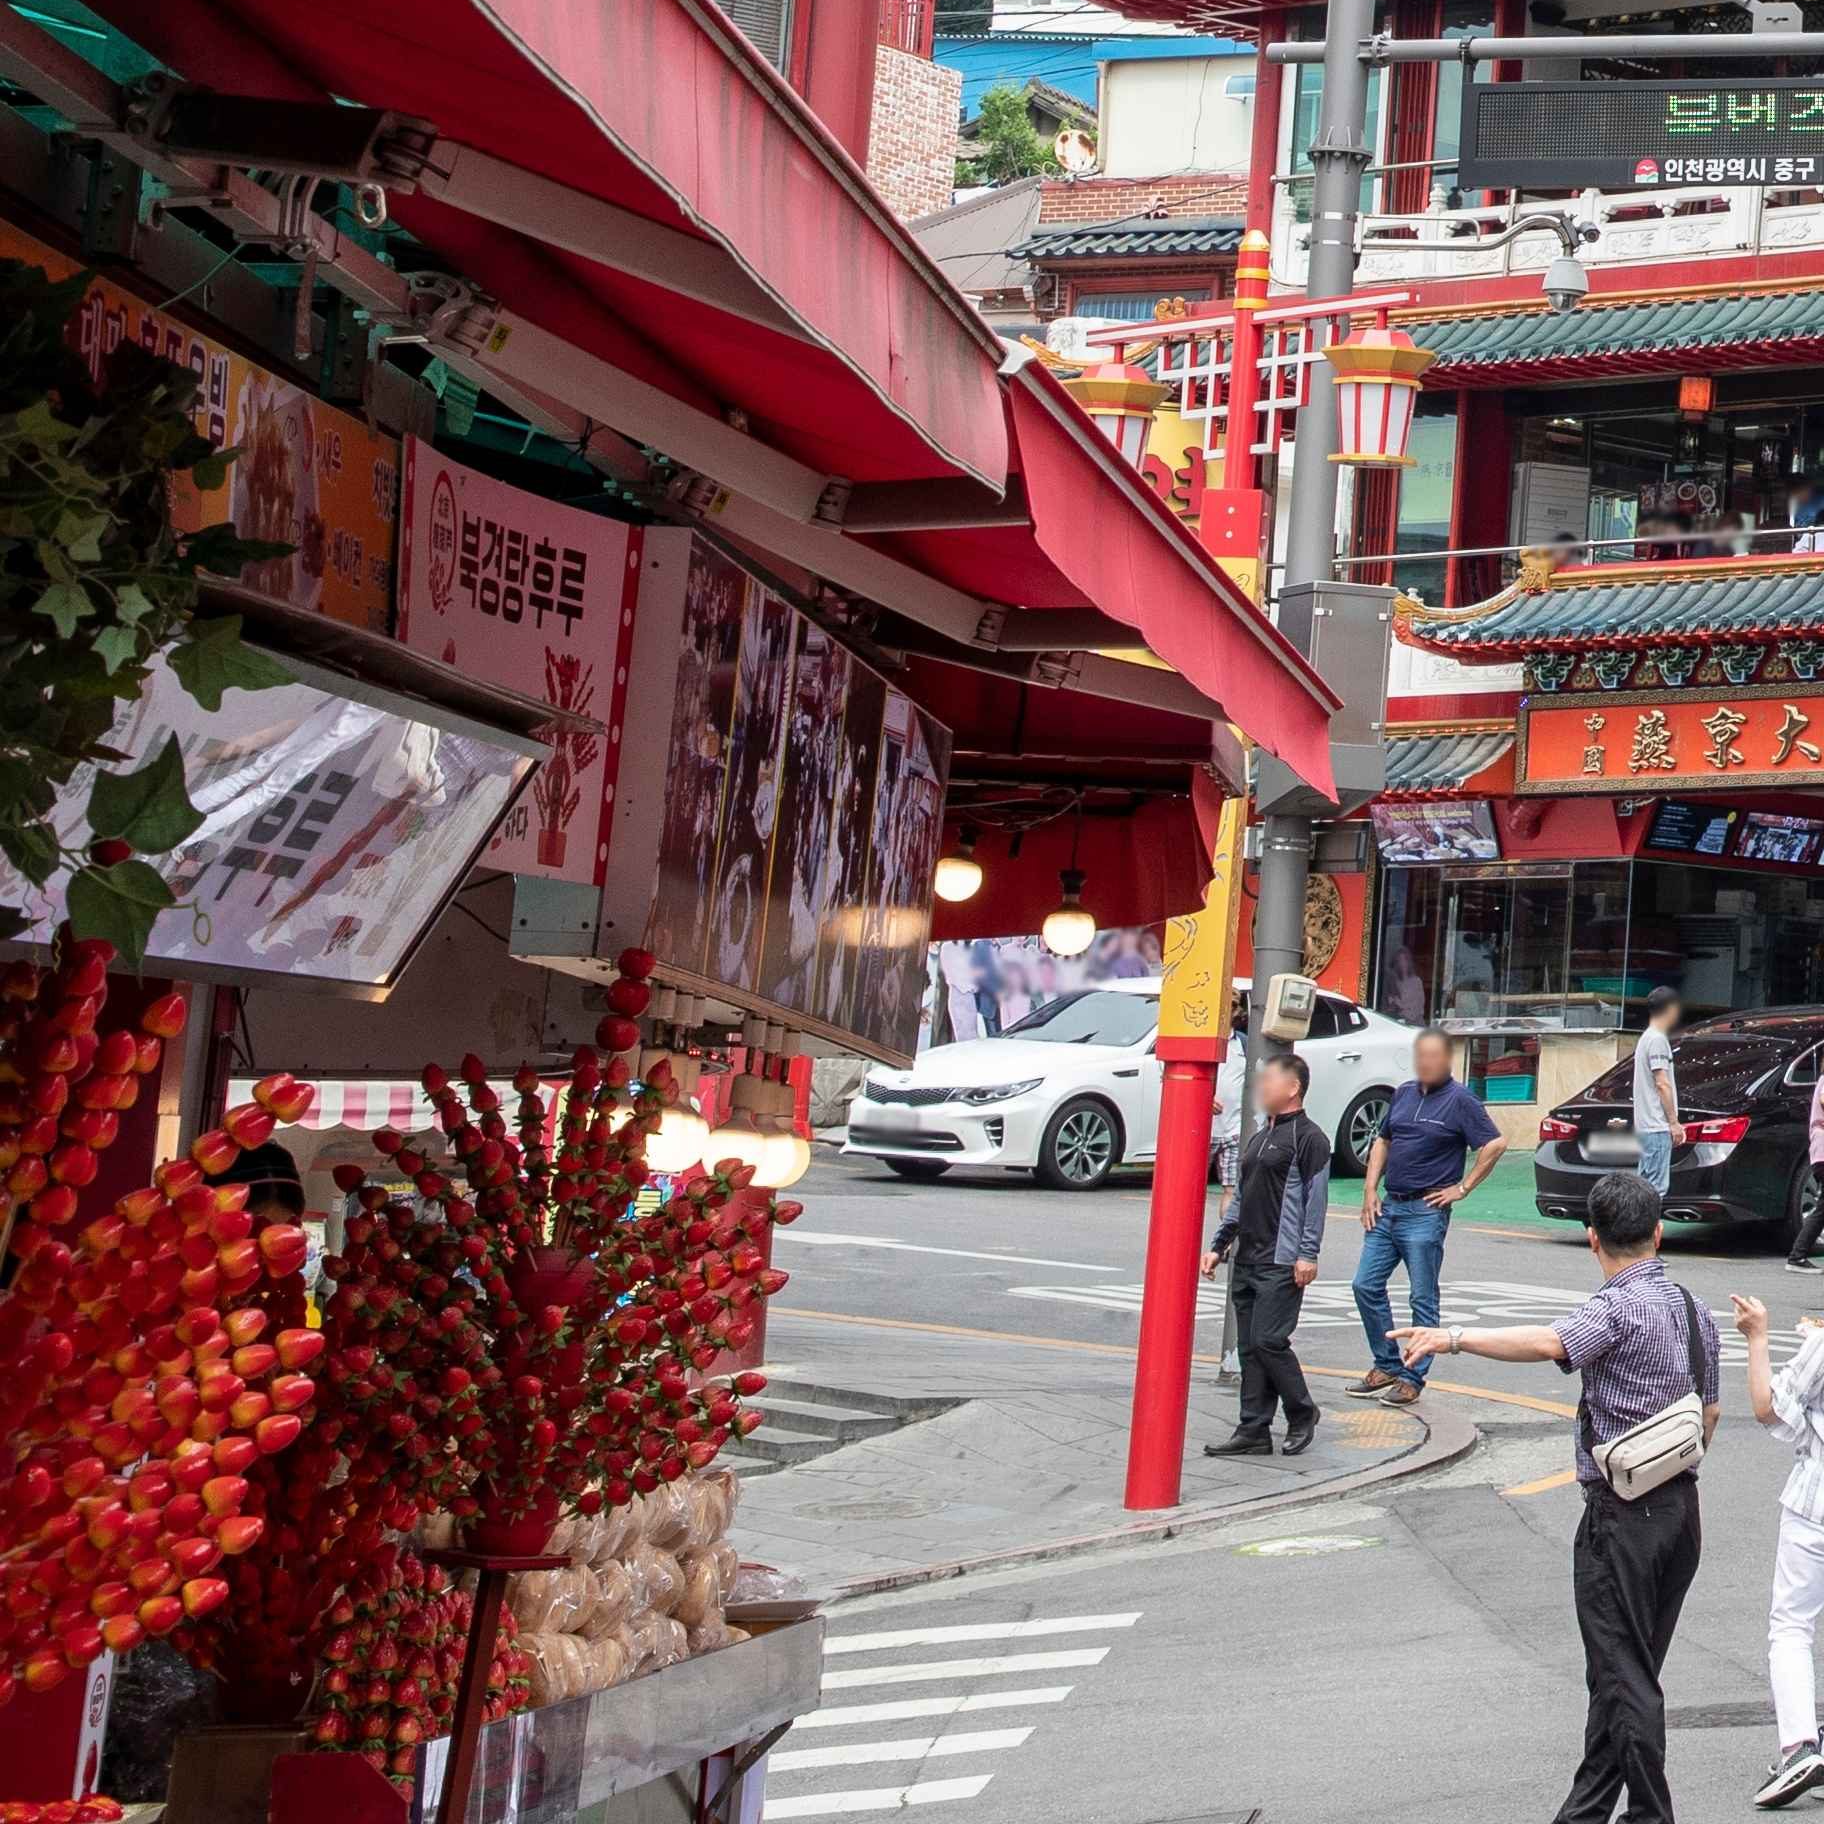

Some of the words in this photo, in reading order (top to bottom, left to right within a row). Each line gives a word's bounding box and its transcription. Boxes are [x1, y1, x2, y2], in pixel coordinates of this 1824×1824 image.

[1665, 157, 1766, 182] 인천광역시
[1774, 157, 1816, 182] 중구
[459, 510, 588, 638] 북경탕후루
